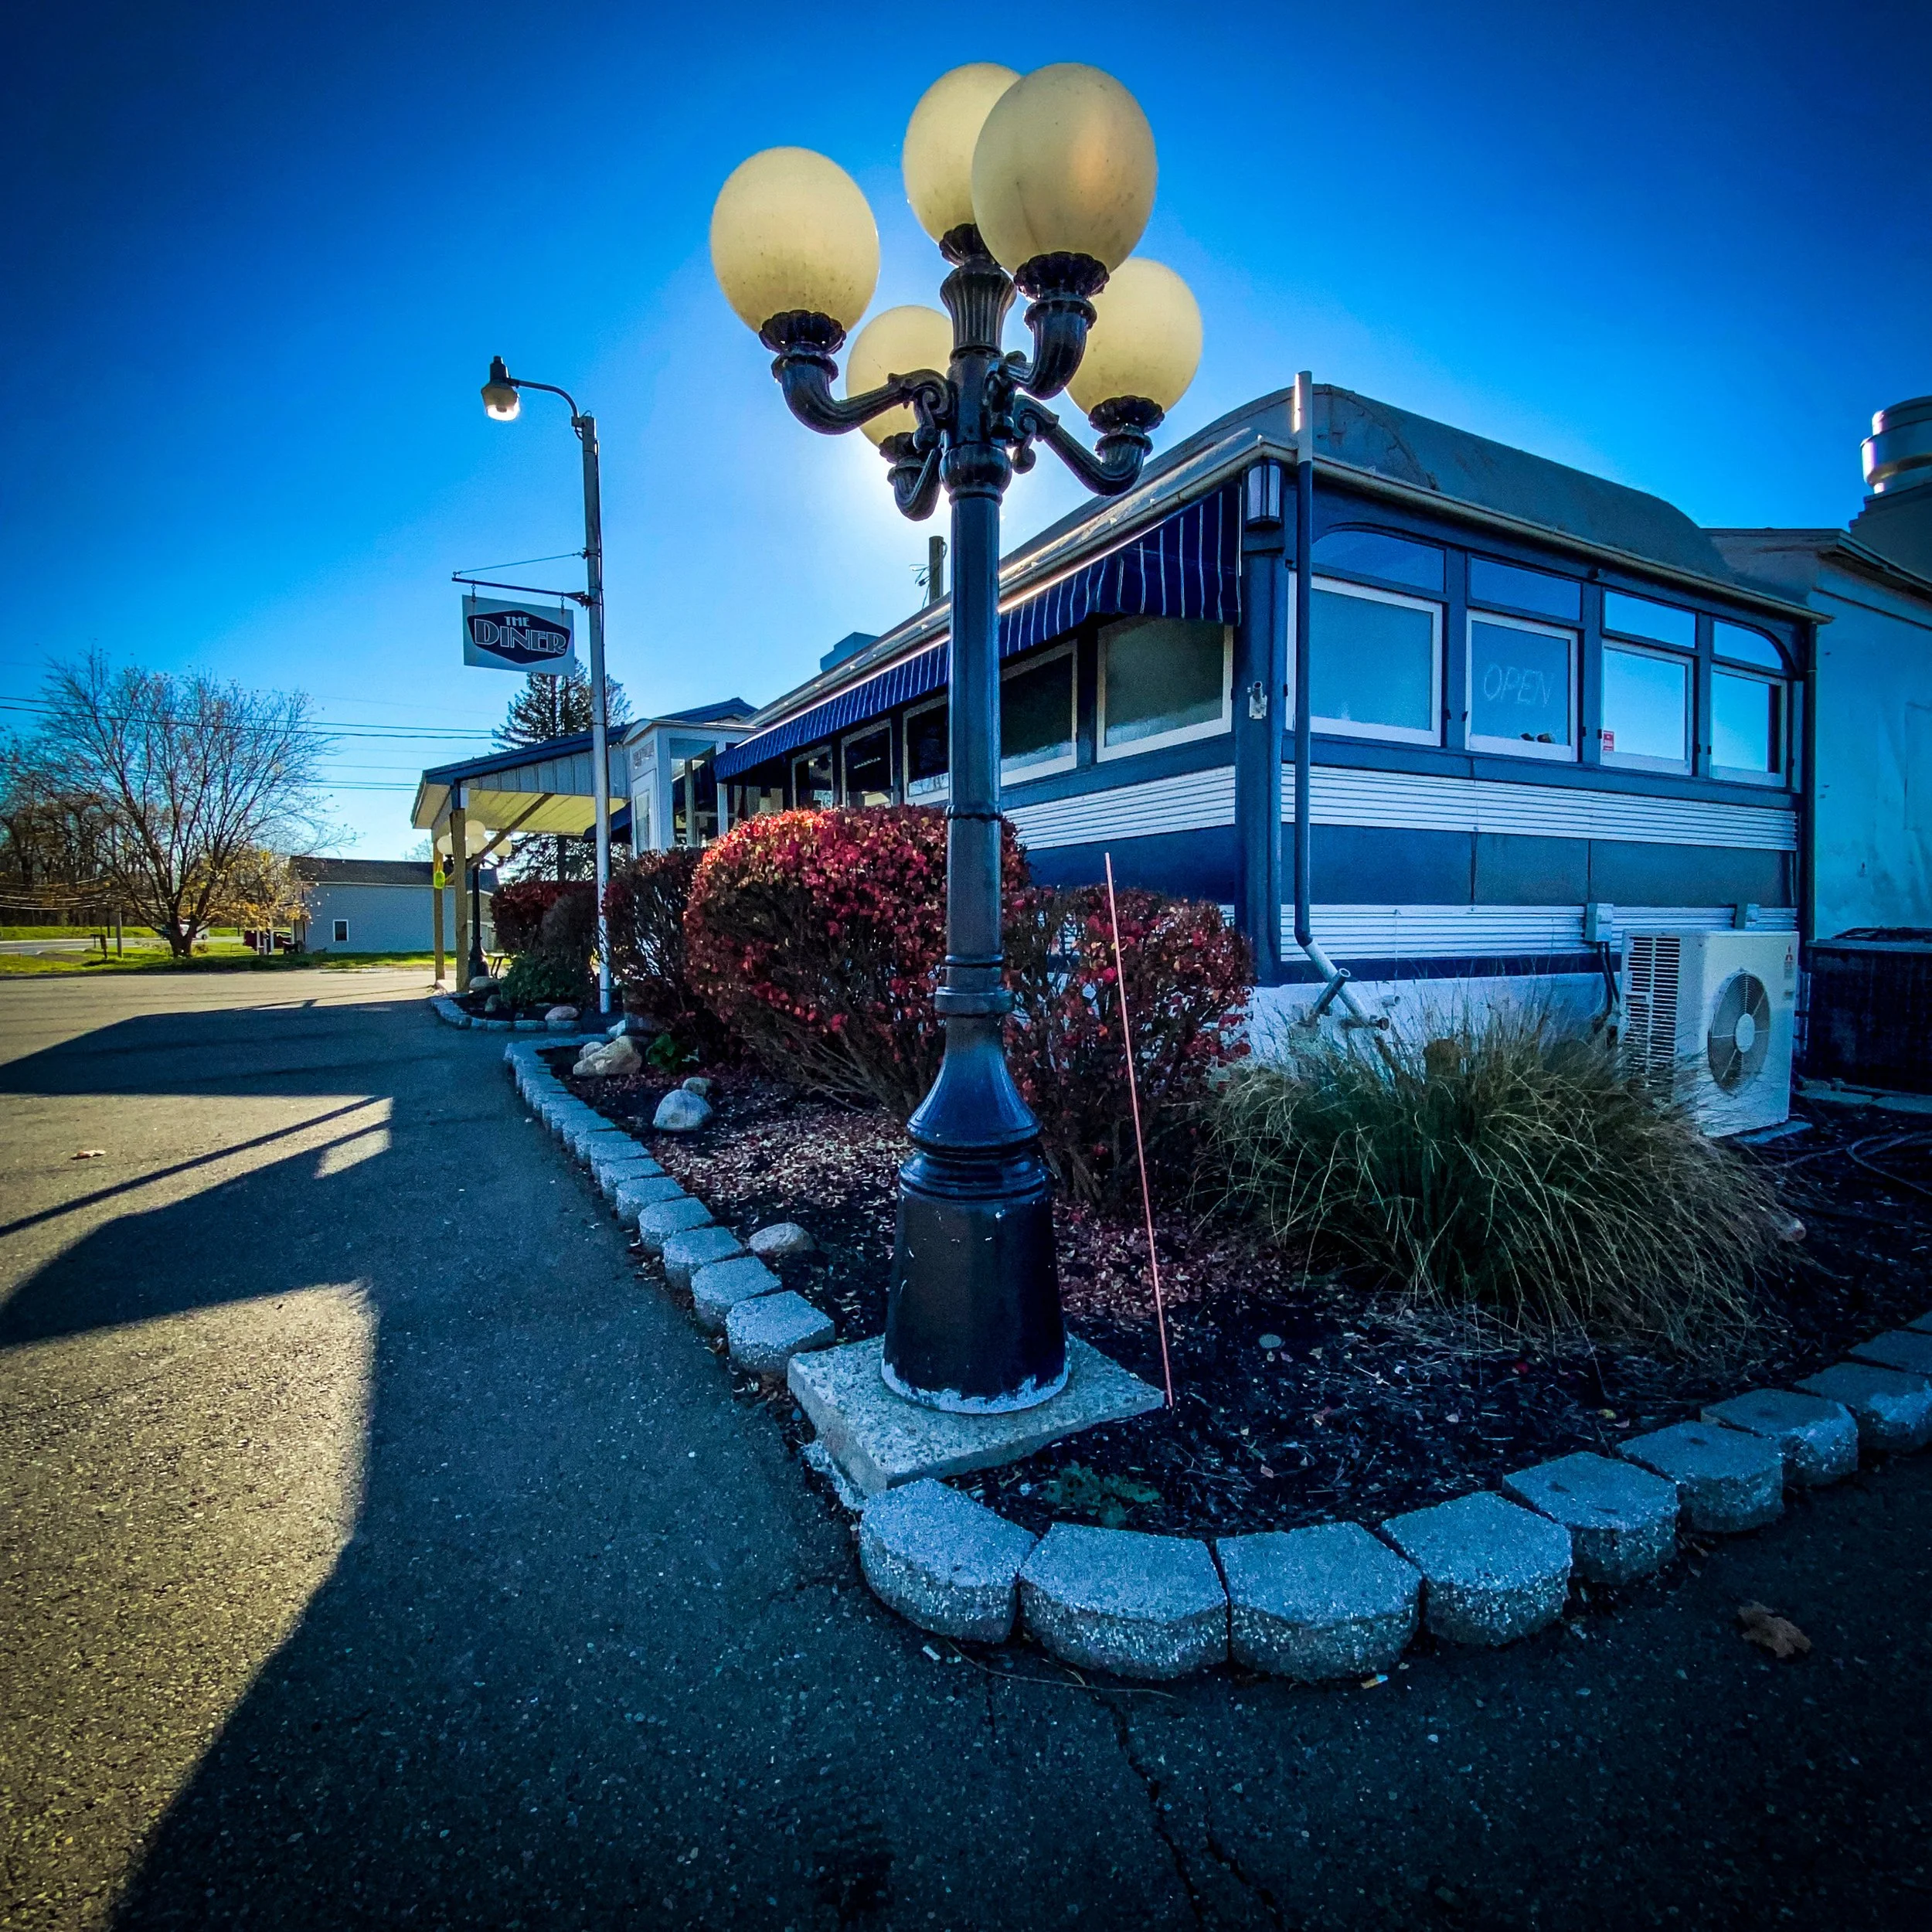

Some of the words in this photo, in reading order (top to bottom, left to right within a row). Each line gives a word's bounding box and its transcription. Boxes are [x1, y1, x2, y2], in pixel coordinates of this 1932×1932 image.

[474, 618, 566, 655] DINER
[504, 616, 531, 628] THE
[1484, 664, 1553, 706] OPEN
